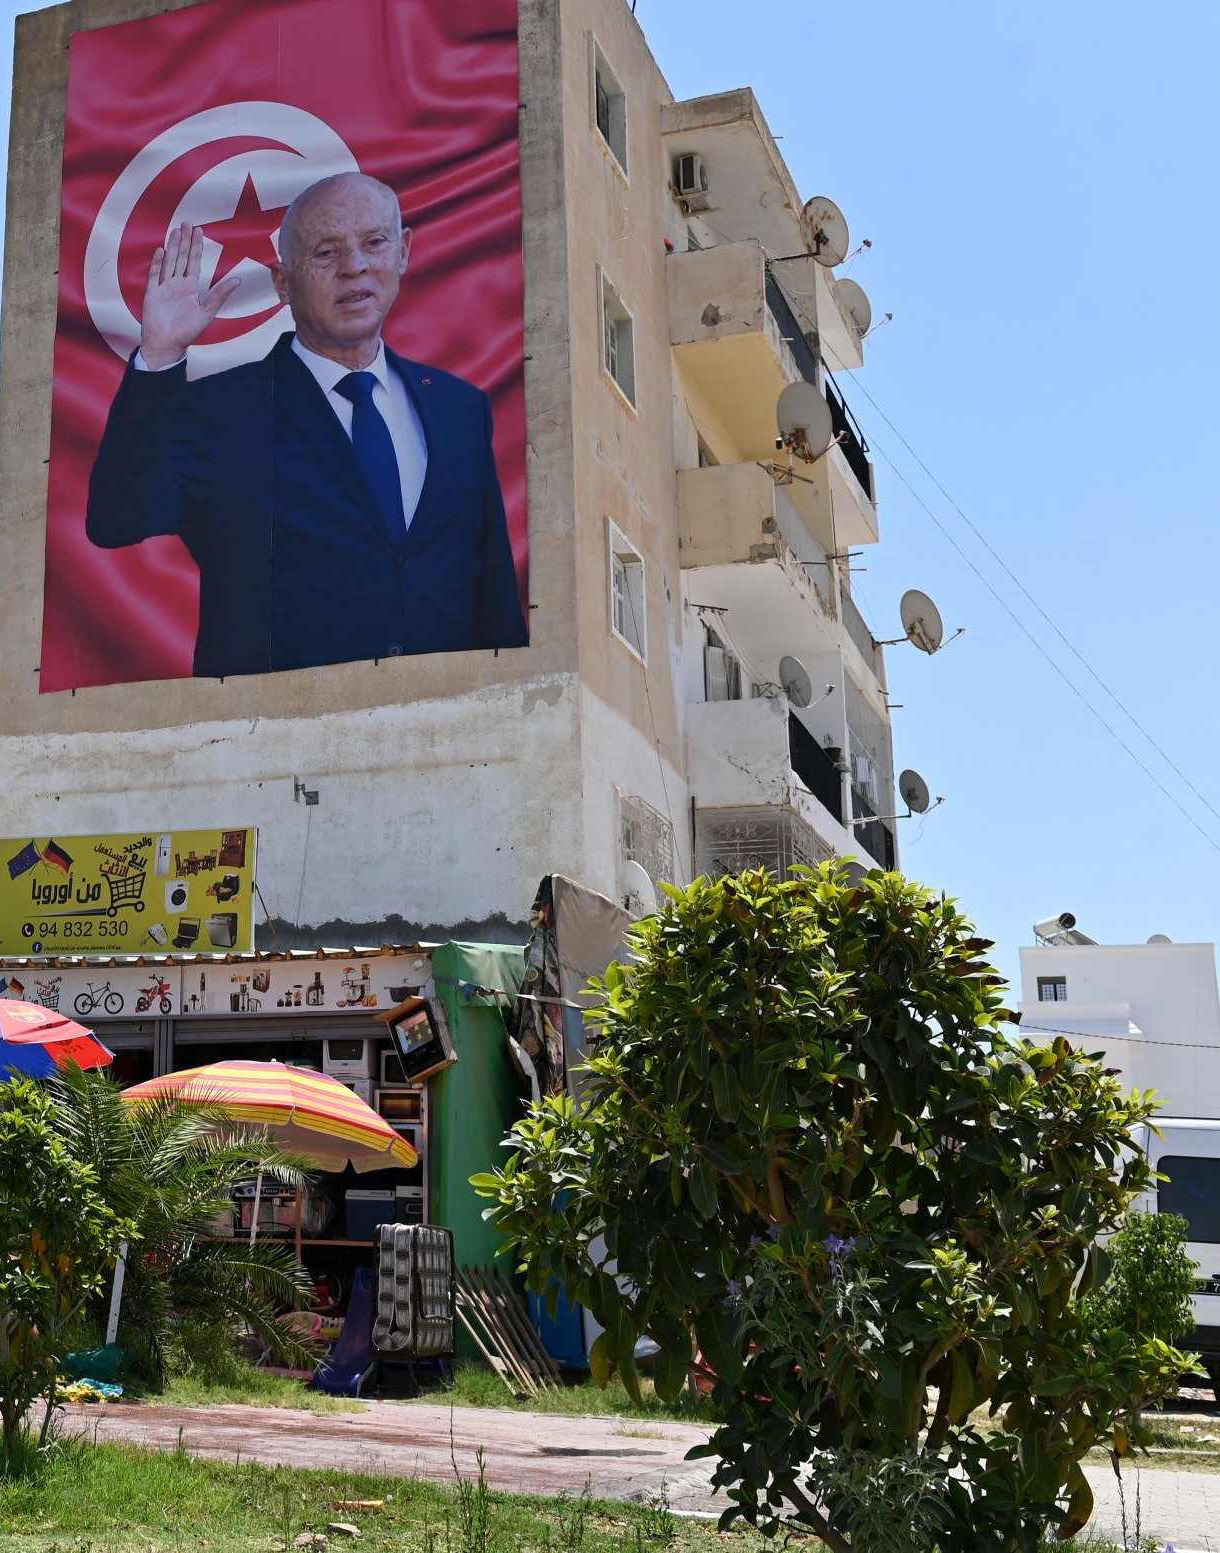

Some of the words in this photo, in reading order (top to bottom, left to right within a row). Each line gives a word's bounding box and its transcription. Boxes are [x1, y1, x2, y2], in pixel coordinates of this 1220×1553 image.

[128, 853, 148, 872] بيع
[31, 872, 74, 905] أوروبا
[76, 878, 102, 904] من
[38, 922, 59, 938] 94
[63, 921, 93, 937] 832
[98, 920, 128, 937] 530
